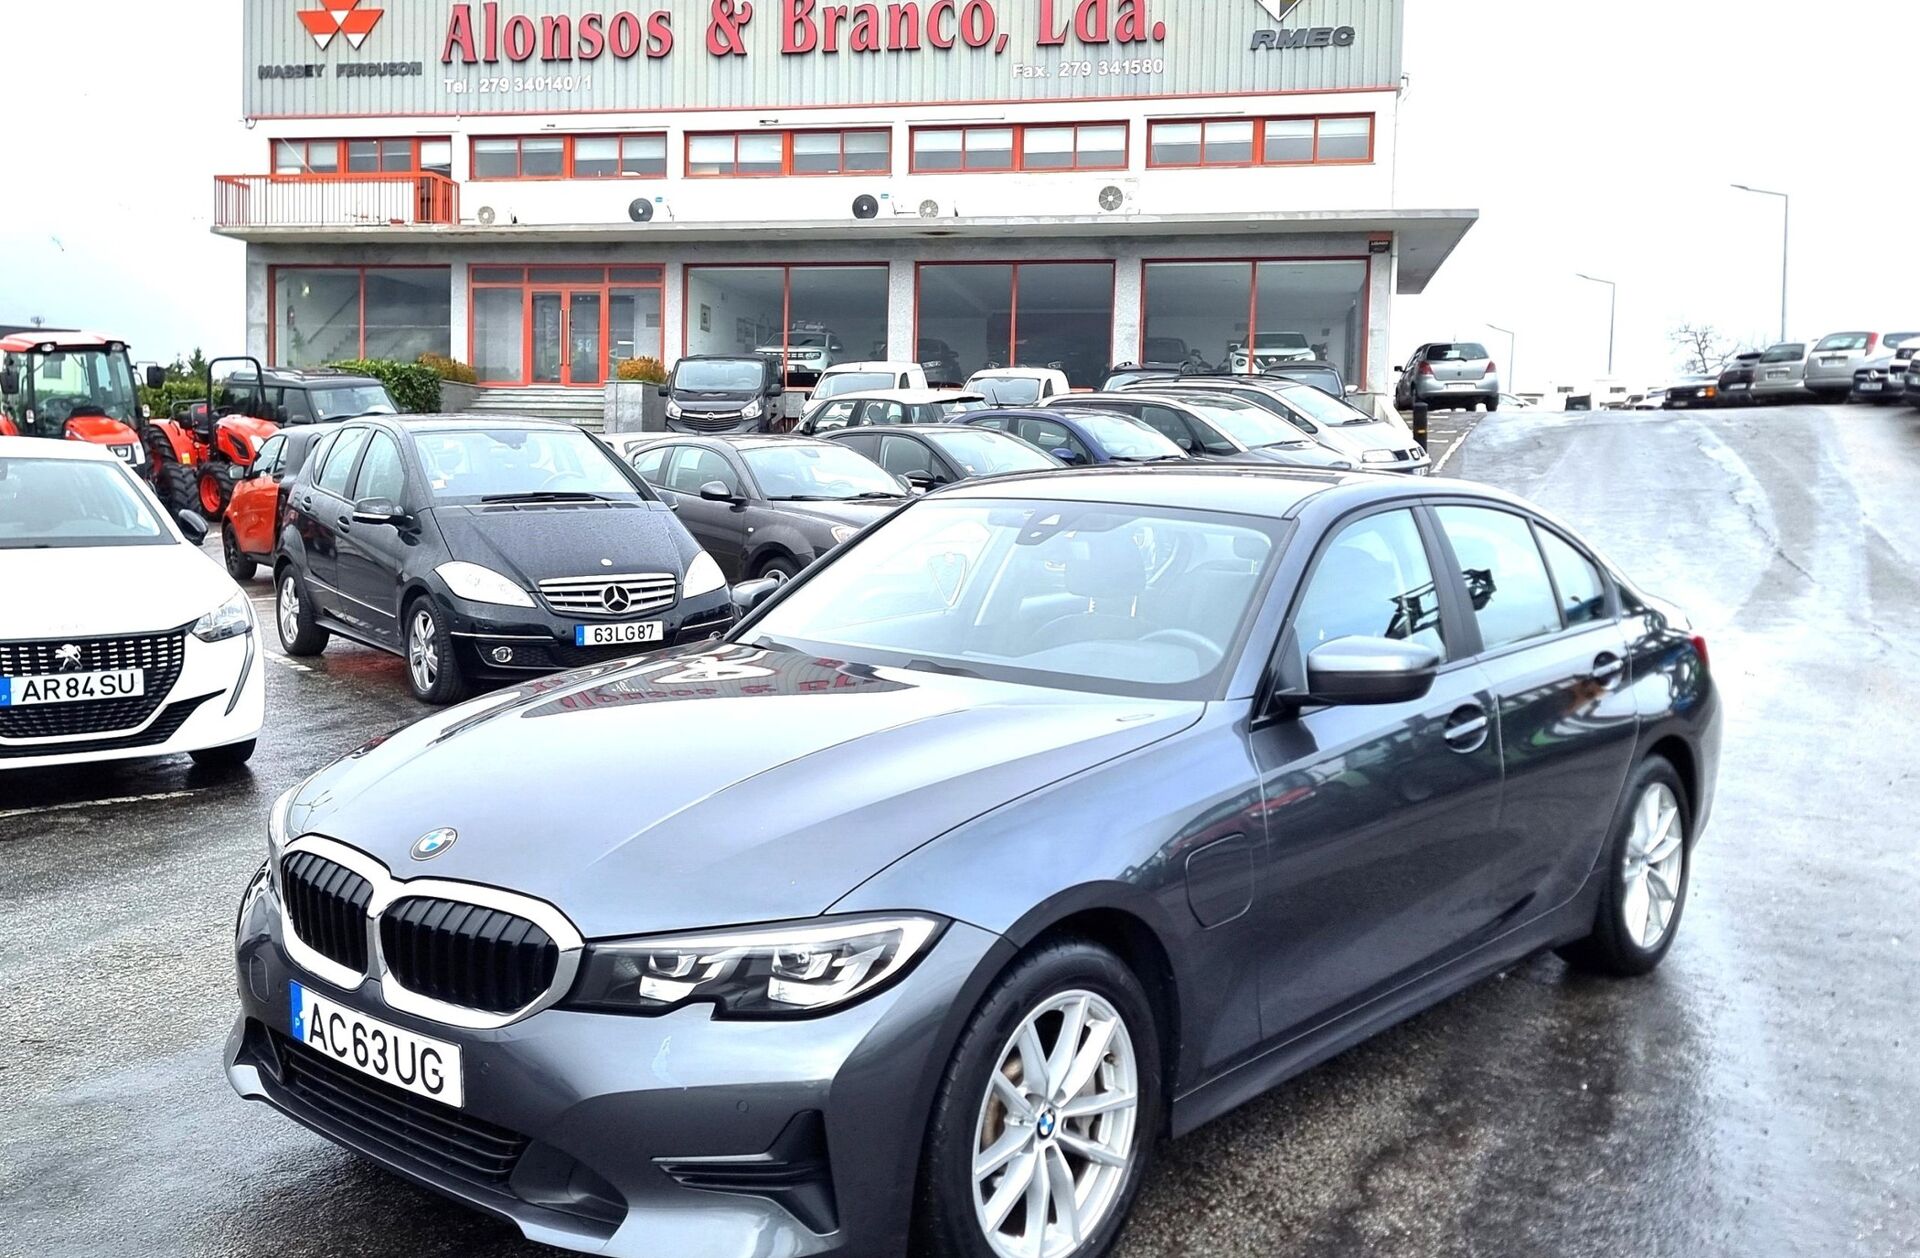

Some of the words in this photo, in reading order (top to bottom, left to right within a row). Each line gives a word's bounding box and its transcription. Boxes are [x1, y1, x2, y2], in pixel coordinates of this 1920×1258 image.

[441, 2, 674, 64] Alonsos
[706, 0, 753, 56] &
[781, 0, 1009, 56] Branco,
[1037, 0, 1167, 46] Lda.
[1250, 26, 1356, 50] RMEC
[258, 63, 325, 79] MASSEY
[336, 61, 422, 78] FERGUSON
[1012, 63, 1050, 79] Fax.
[1058, 61, 1092, 77] 279
[1098, 59, 1164, 76] 341580
[444, 78, 473, 94] Tel.
[479, 77, 510, 93] 279
[514, 75, 592, 92] 340140/1
[594, 624, 654, 643] 63LG87
[309, 1002, 445, 1095] AC63UG
